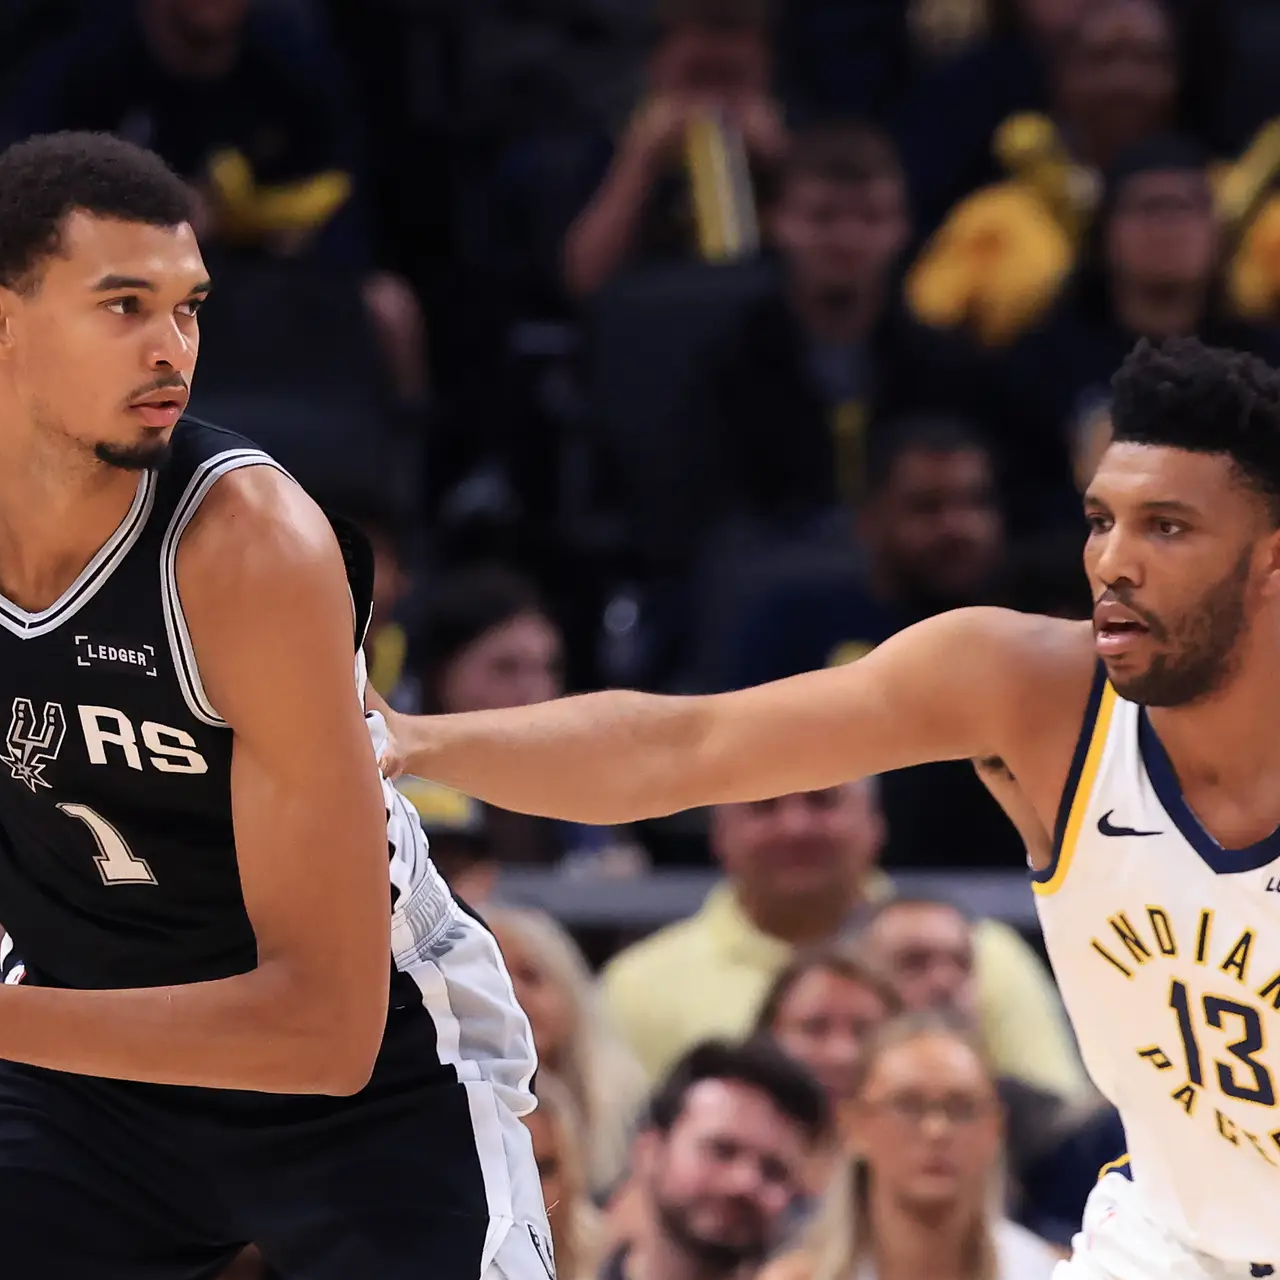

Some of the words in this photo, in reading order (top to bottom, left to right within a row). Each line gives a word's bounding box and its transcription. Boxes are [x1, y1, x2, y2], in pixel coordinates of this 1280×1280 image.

[87, 643, 147, 667] LEDGER
[55, 802, 158, 886] 1
[1168, 976, 1280, 1109] 13
